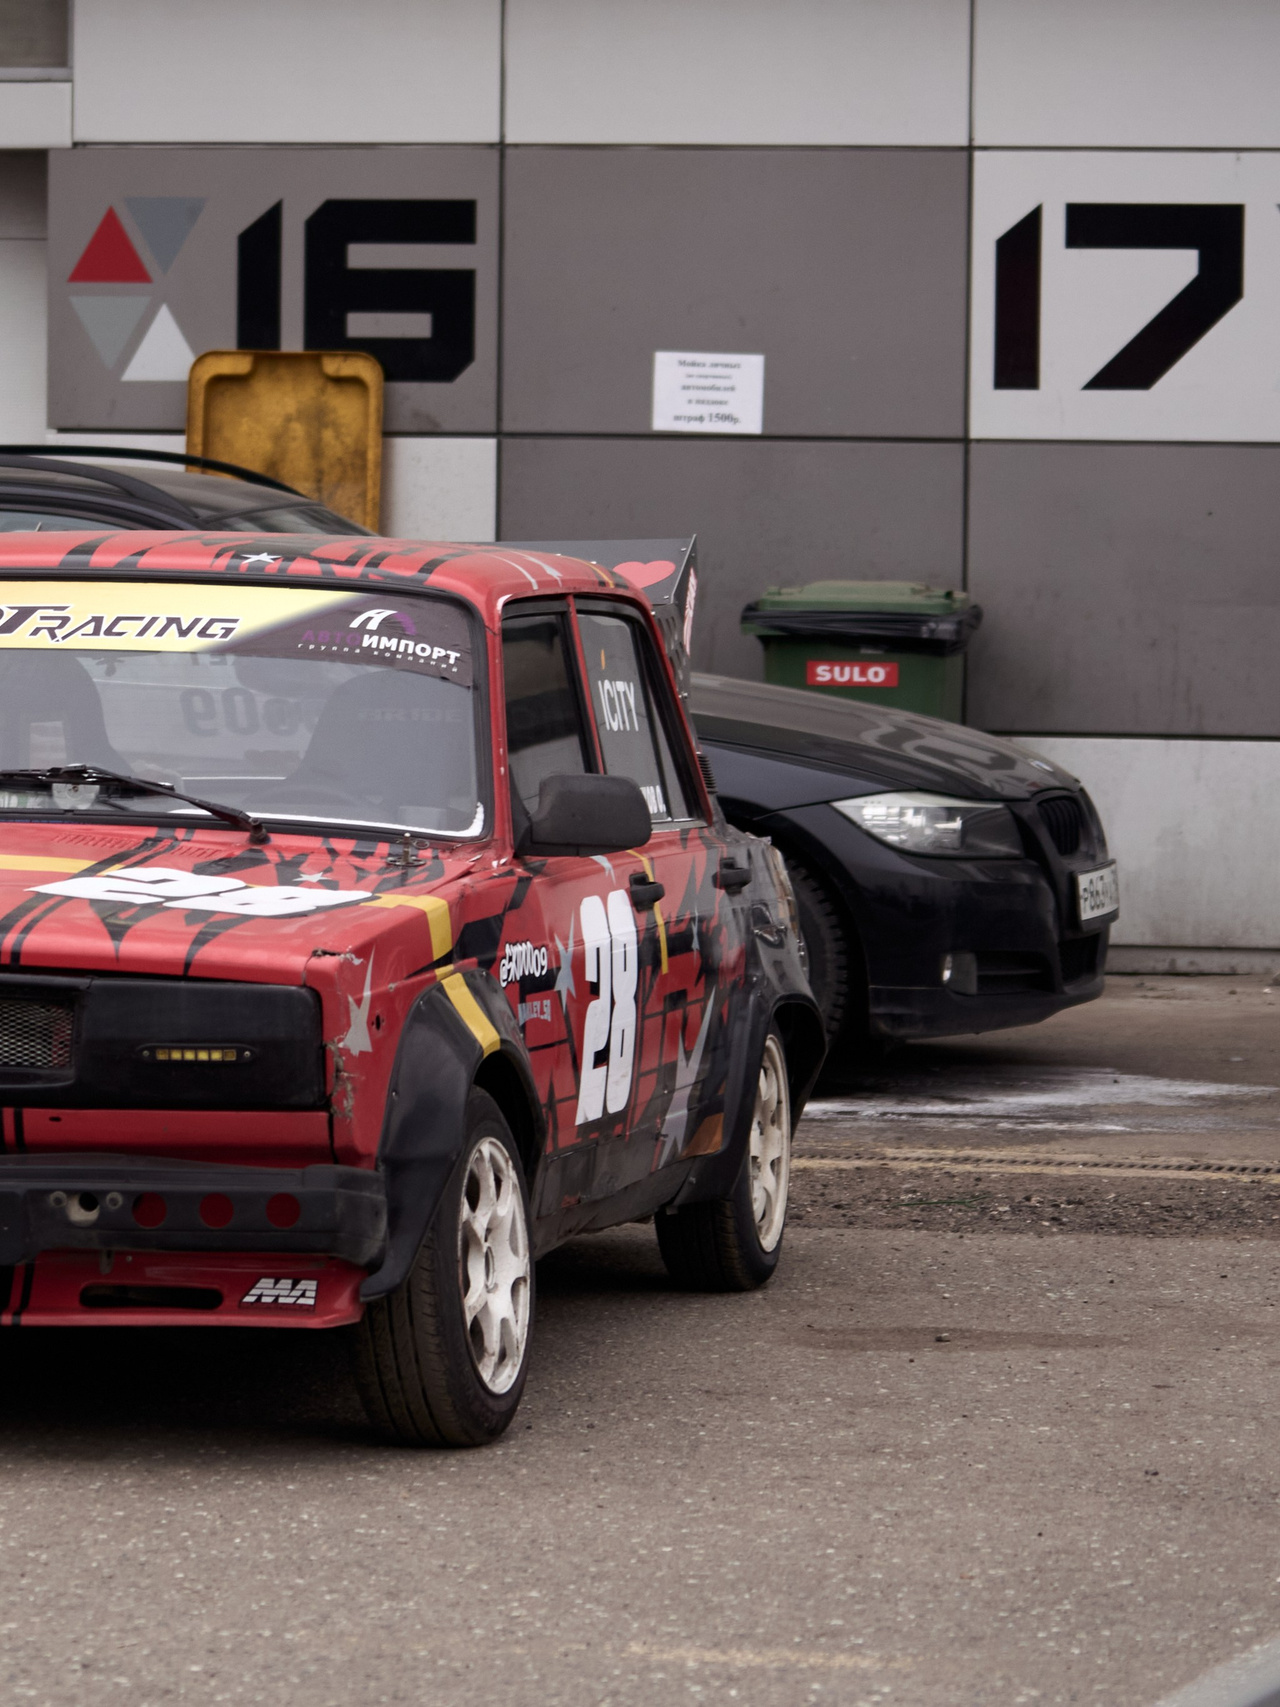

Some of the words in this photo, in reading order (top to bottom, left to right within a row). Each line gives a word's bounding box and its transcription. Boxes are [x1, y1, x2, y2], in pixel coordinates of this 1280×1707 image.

[237, 198, 477, 384] 16
[994, 203, 1246, 391] 17
[297, 643, 361, 653] группа
[373, 651, 458, 672] компаний
[815, 665, 887, 683] SULO
[23, 867, 376, 917] 28
[575, 889, 639, 1126] 28
